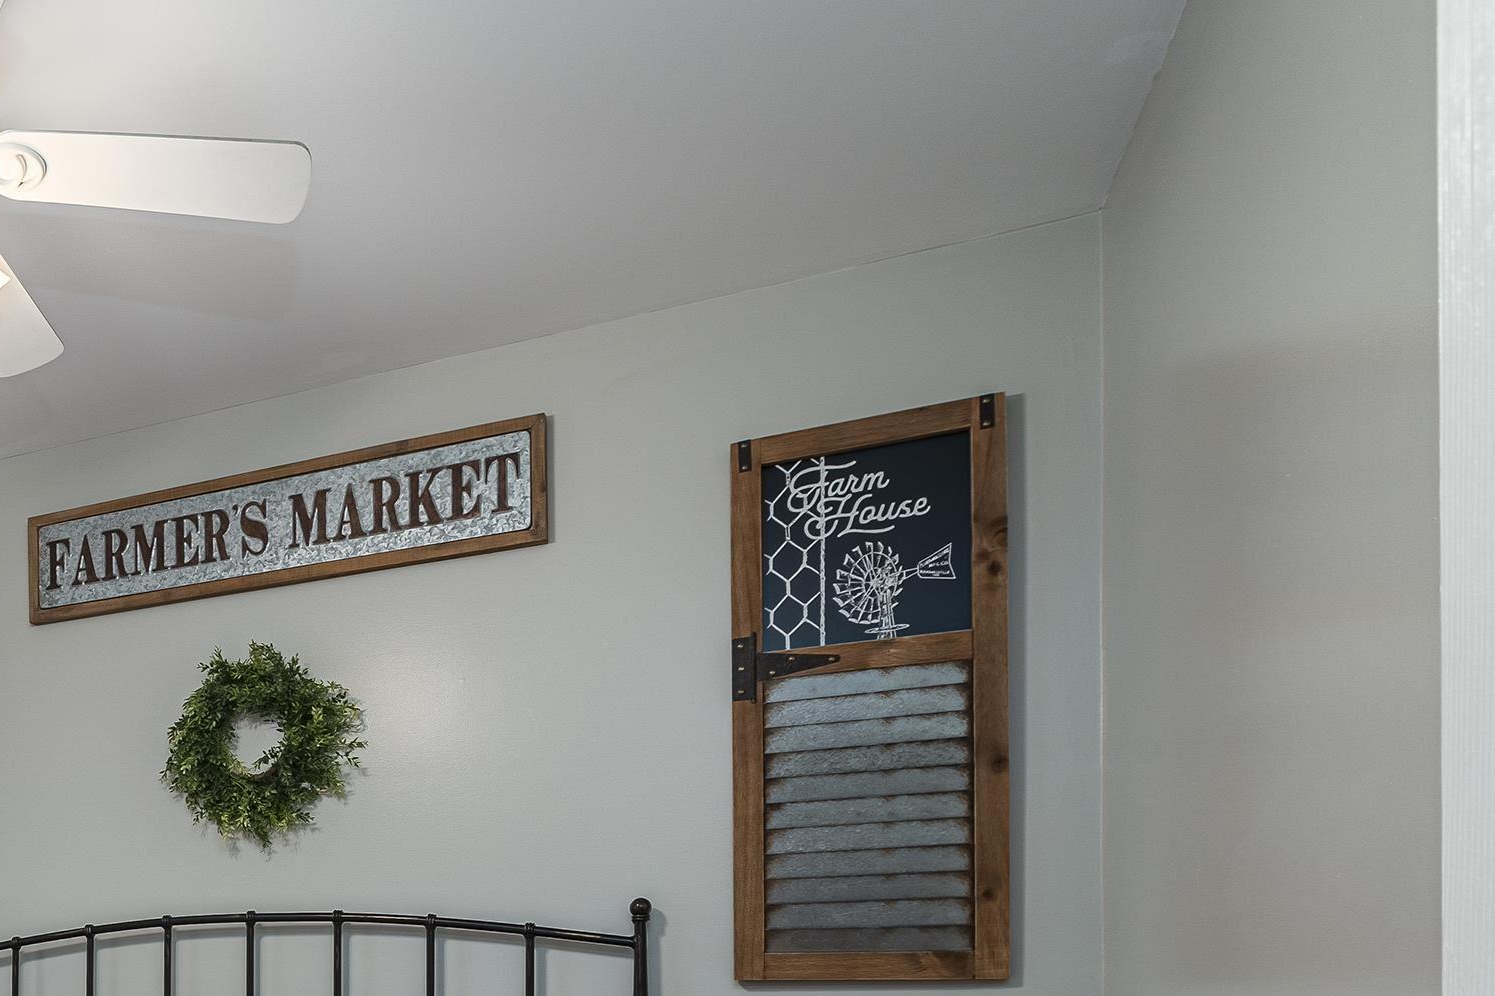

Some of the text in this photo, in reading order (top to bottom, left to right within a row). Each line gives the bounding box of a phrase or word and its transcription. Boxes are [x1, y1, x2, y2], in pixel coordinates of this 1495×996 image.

[787, 460, 889, 512] Farm
[46, 452, 521, 590] FARMER'S MARKET
[803, 494, 931, 539] House
